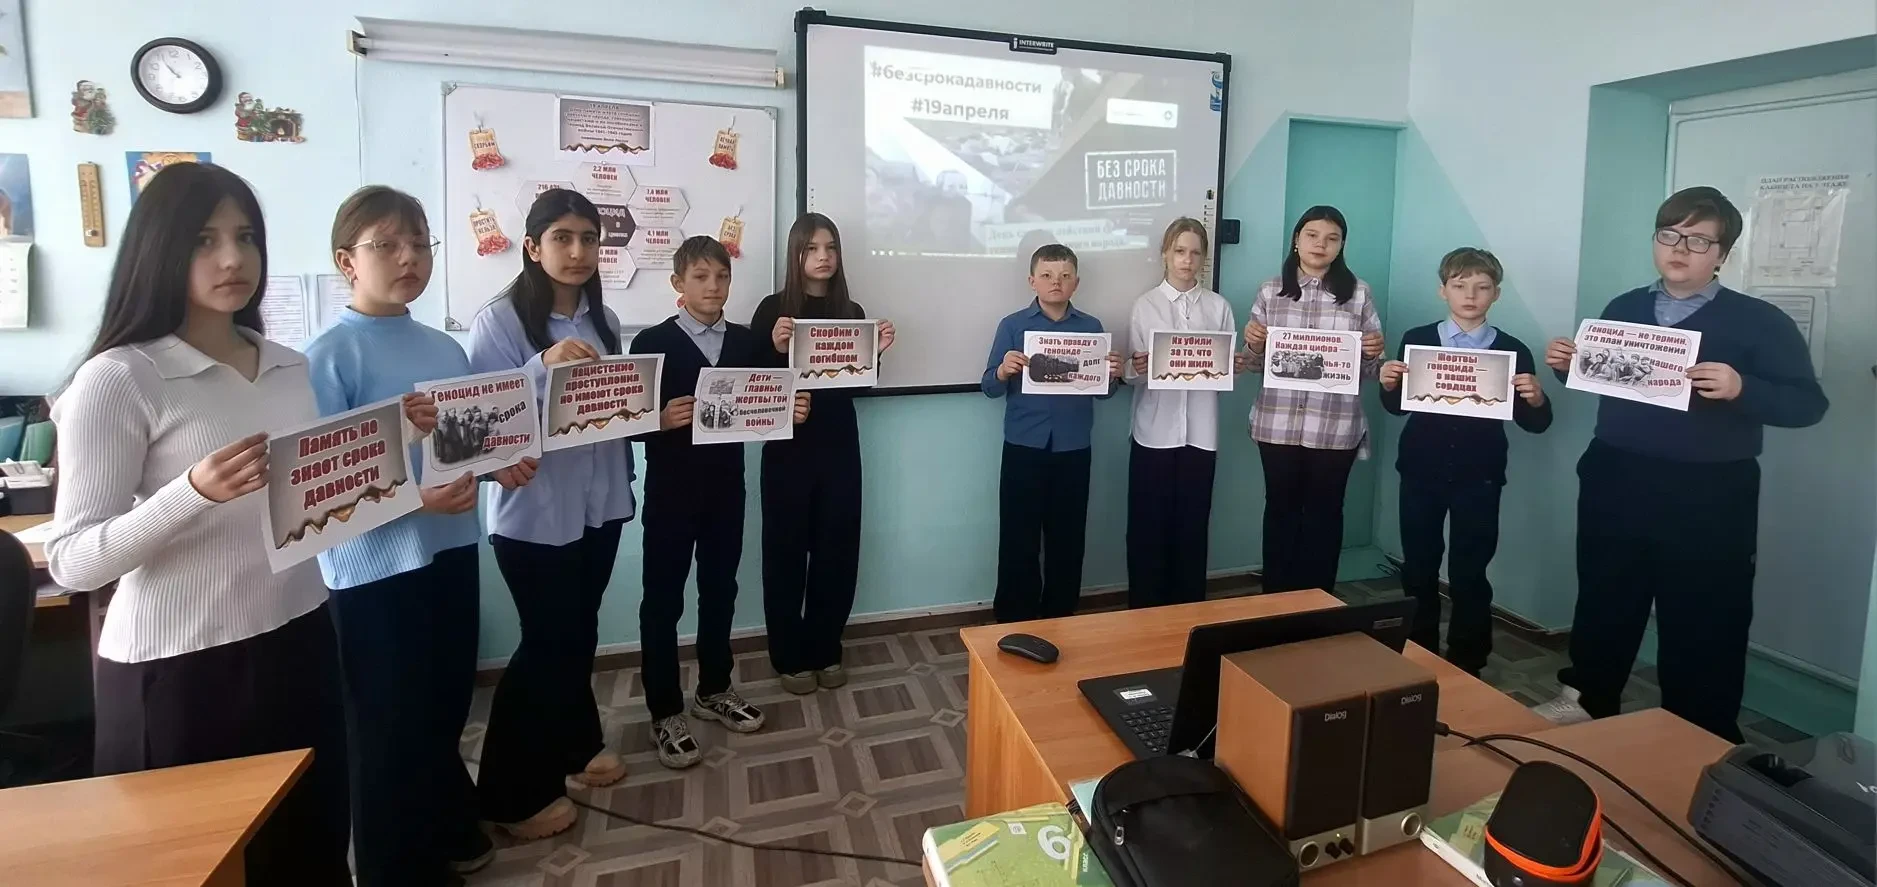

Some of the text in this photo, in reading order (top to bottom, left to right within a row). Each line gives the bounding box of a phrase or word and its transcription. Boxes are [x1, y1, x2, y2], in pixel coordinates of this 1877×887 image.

[1019, 40, 1054, 48] INTERWRITE
[911, 97, 1010, 121] #19апреля
[1097, 158, 1166, 179] БЕЗ СРОКА
[592, 173, 618, 181] ЧЕЛОВЕК
[1098, 180, 1166, 202] ДАВНОСТИ
[810, 326, 860, 338] Скорбим о
[1283, 332, 1291, 340] 27
[1587, 325, 1625, 337] Геноцид
[1638, 332, 1650, 340] не
[815, 341, 854, 351] каждом
[1039, 337, 1062, 345] Знать
[1063, 338, 1091, 346] правду
[1172, 336, 1212, 346] Их убили
[1599, 337, 1622, 345] план
[1624, 340, 1686, 355] уничтожения
[1043, 348, 1081, 356] геноциде
[1275, 342, 1308, 351] Каждая
[1309, 345, 1338, 353] цифра
[1183, 349, 1195, 357] то,
[1197, 349, 1212, 357] что
[1437, 353, 1478, 363] Жертвы
[810, 353, 857, 364] погибшем
[1083, 358, 1101, 367] долг
[1169, 360, 1187, 368] они
[1323, 361, 1351, 369] чья-то
[1427, 363, 1474, 373] геноцида
[1649, 358, 1684, 372] нашего
[572, 363, 635, 378] Нацистские
[749, 373, 771, 382] Дети
[1068, 372, 1101, 382] каждого
[1322, 373, 1351, 381] жизнь
[1444, 374, 1477, 383] наших
[565, 374, 640, 391] преступления
[1436, 382, 1477, 392] сердцах
[1647, 379, 1682, 387] народа
[431, 379, 525, 402] Геноцид не имеет
[745, 384, 782, 392] главные
[560, 385, 644, 405] не имеют срока
[735, 394, 787, 404] жертвы той
[498, 400, 526, 423] срока
[577, 399, 628, 415] давности
[739, 406, 786, 415] бесчеловечной
[745, 417, 775, 427] войны
[299, 419, 378, 458] Память не
[483, 433, 530, 448] давности
[290, 440, 386, 486] знает срока
[303, 465, 380, 510] давности
[1401, 694, 1422, 705] Dialog
[1324, 710, 1347, 722] Dialog
[1037, 825, 1071, 860] 6
